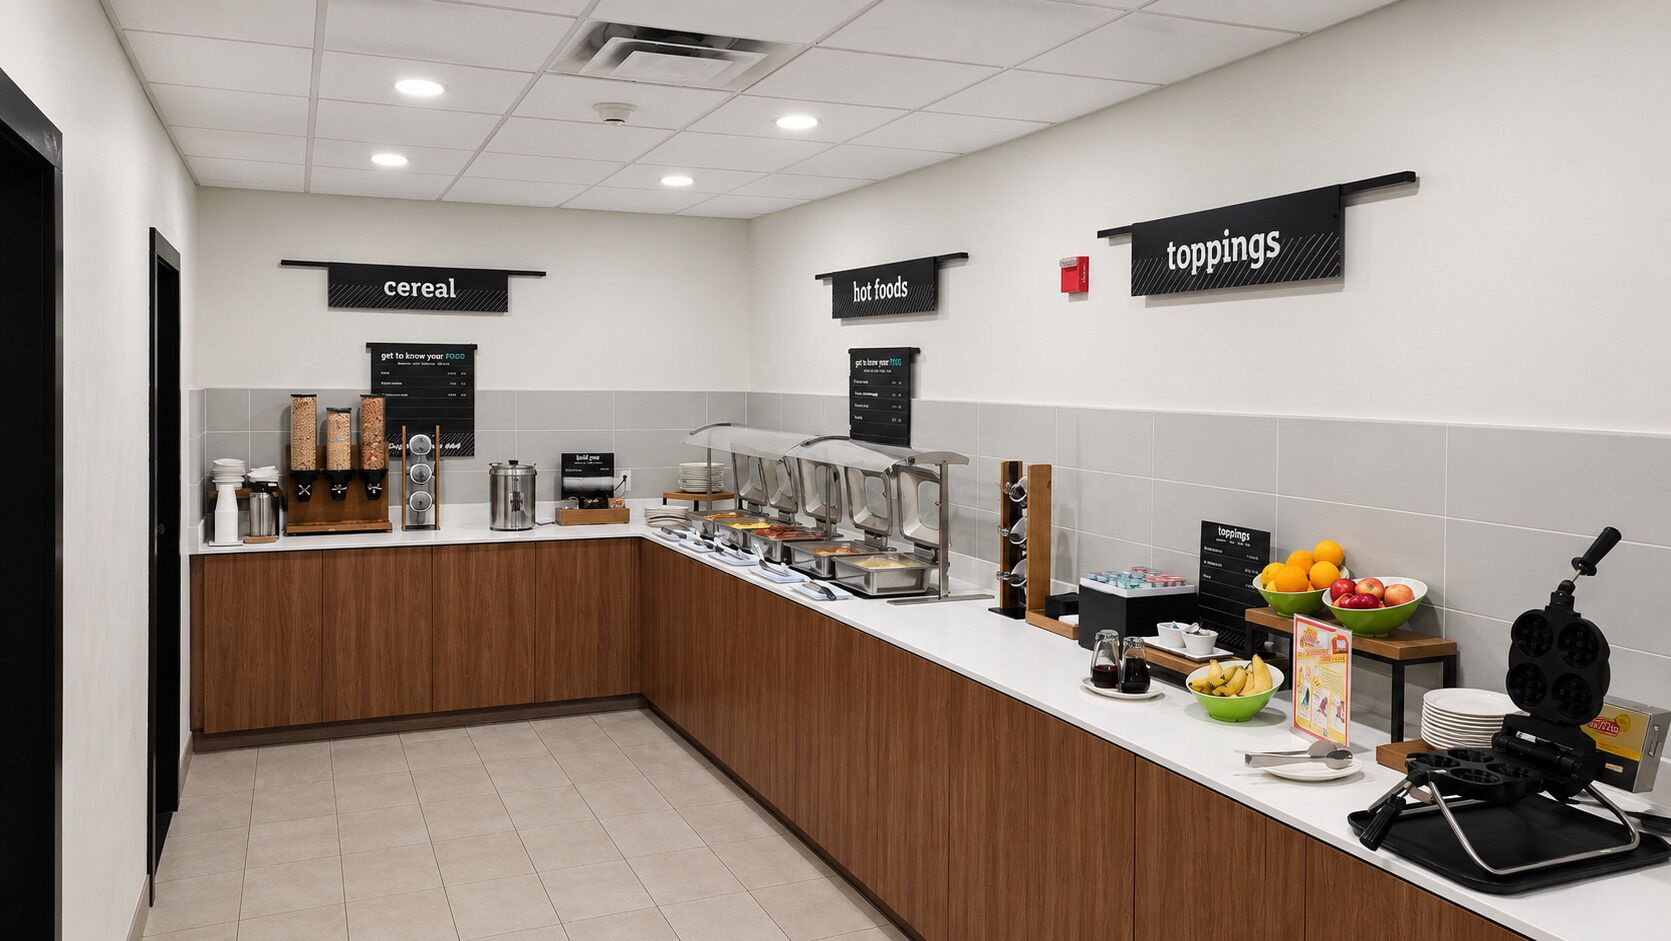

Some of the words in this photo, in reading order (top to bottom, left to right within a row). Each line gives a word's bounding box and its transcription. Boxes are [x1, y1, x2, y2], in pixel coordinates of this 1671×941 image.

[1167, 228, 1281, 276] toppings
[383, 277, 457, 298] cereal
[853, 280, 872, 302] hot
[874, 275, 908, 300] foods
[381, 352, 394, 361] get
[395, 352, 404, 360] to
[405, 351, 425, 360] know
[1218, 526, 1251, 542] toppings
